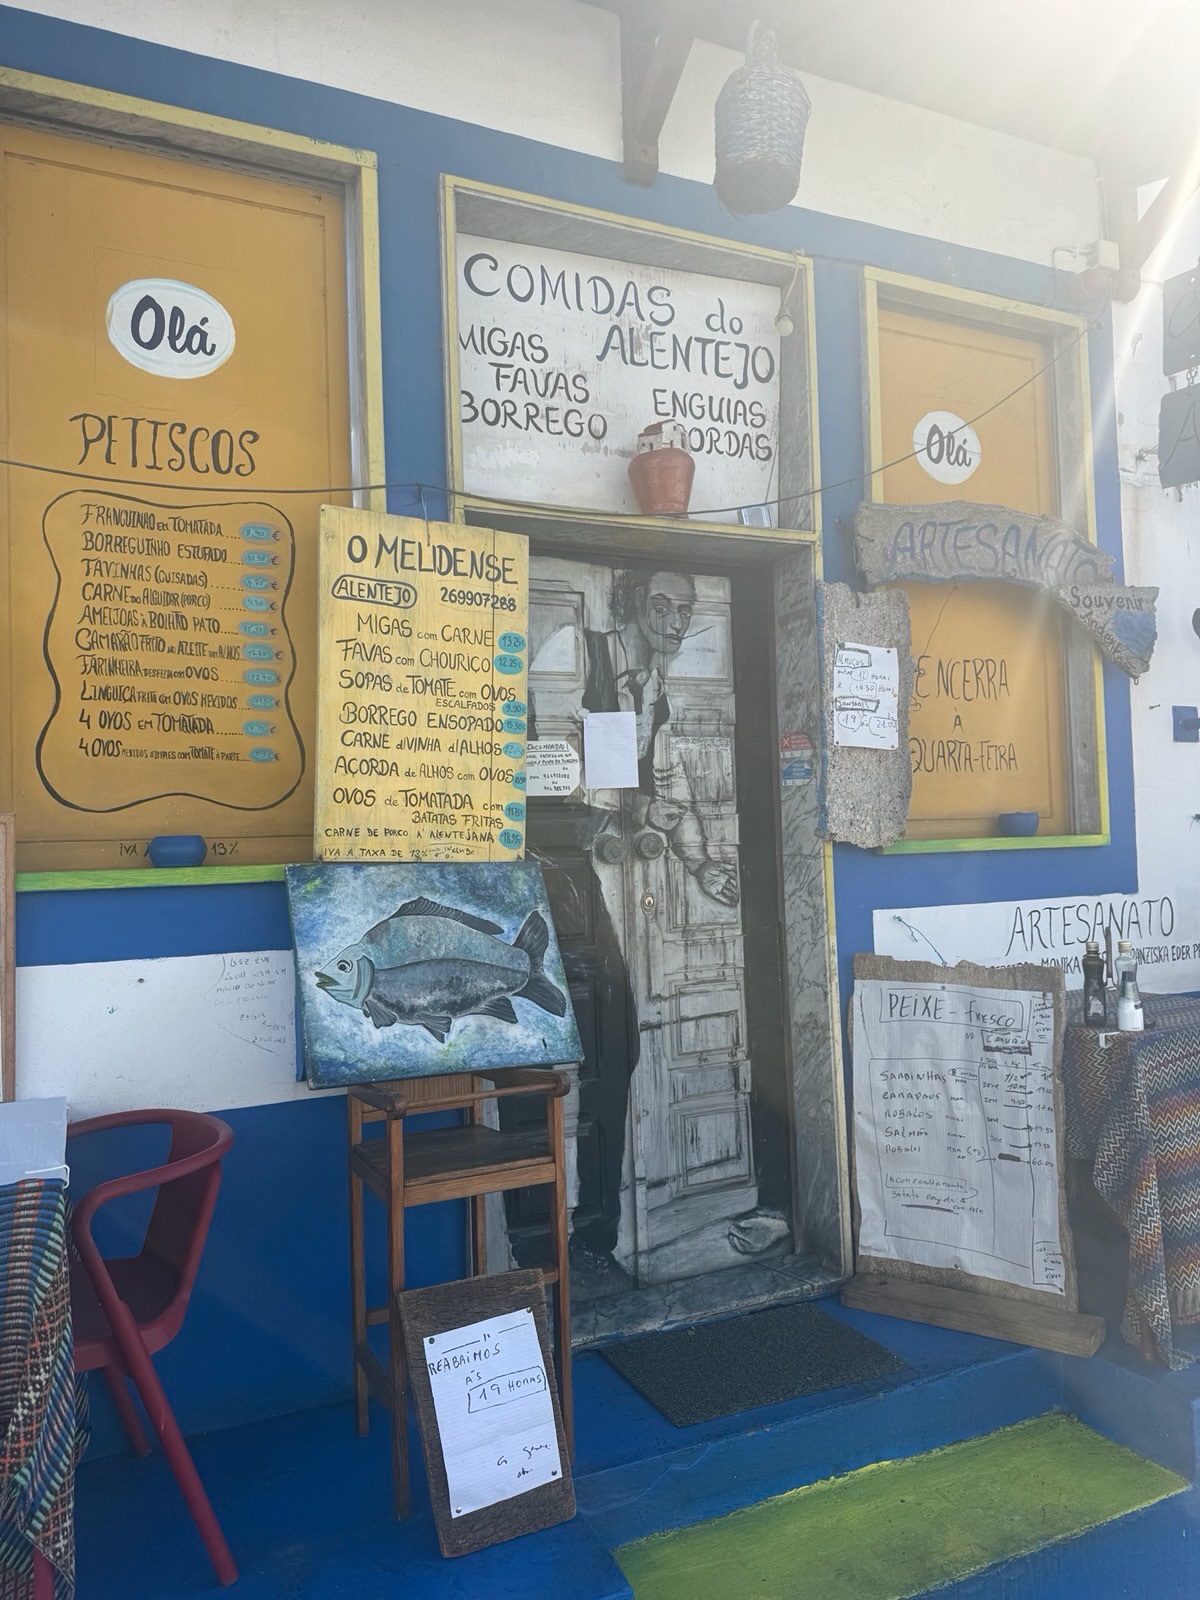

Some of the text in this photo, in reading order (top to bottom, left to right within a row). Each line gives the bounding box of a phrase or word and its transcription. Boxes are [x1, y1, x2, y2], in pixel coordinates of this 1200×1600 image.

[463, 253, 675, 327] COMIDAS
[131, 294, 216, 356] Olá
[705, 298, 743, 335] do
[459, 323, 549, 364] MIGAS
[596, 324, 775, 389] ALENTEJO
[488, 362, 590, 403] FAVAS
[461, 390, 608, 440] BORREGO
[652, 389, 766, 428] ENGUIAS
[69, 412, 260, 476] PETISCOS
[927, 424, 971, 467] Olá
[80, 503, 155, 531] FRANGUINHO
[167, 515, 224, 538] TOMATADA
[81, 530, 171, 557] BORREGUINHO
[177, 543, 227, 563] ESTUFADO
[347, 533, 518, 585] O MELIDENSE
[889, 519, 1100, 585] ARTESANATO
[81, 582, 132, 603] CARNE
[154, 564, 208, 589] (GUISADAS)
[336, 578, 411, 606] ALENTEJO
[440, 586, 517, 612] 269907288
[1070, 585, 1143, 614] Souvenir
[76, 604, 140, 628] AMEIJOAS
[192, 616, 221, 634] PATO
[357, 612, 413, 638] MIGAS
[417, 630, 438, 641] com
[441, 624, 495, 647] CARNE
[75, 627, 139, 652] CAMARÃO
[138, 634, 166, 653] FRITO
[336, 638, 393, 664] FAVAS
[395, 656, 415, 667] com
[419, 648, 491, 674] CHOURIÇO
[75, 653, 144, 677] FARINHEIRA
[185, 665, 219, 682] OVOS
[914, 655, 1011, 702] ENCERRA
[80, 679, 137, 704] LINGUIÇA
[172, 690, 200, 706] OVOS
[338, 669, 516, 702] SOPAS de TOMATE com OVOS
[339, 700, 418, 727] BORREGO
[427, 712, 504, 733] ENSOPADO
[436, 697, 496, 712] ESCALFADOS
[79, 708, 91, 730] 4
[99, 709, 132, 731] OVOS
[137, 719, 153, 731] EM
[151, 712, 215, 735] TOMATADA
[79, 737, 89, 758] 4
[91, 737, 122, 758] OVOS
[340, 729, 391, 749] CARNE
[909, 737, 1019, 773] QUARTA-FEIRA
[334, 755, 514, 784] AÇORDA de ALHOS com OVOS
[333, 787, 376, 807] OVOS
[384, 797, 399, 807] de
[398, 787, 474, 810] TOMATADA
[482, 801, 504, 812] com
[324, 827, 361, 838] CARNE
[367, 828, 380, 838] DE
[384, 828, 409, 837] PORCO
[429, 829, 495, 844] ALENTEJANA
[411, 811, 504, 829] BATATAS FRITAS
[210, 842, 238, 856] 13%
[324, 847, 341, 858] IVA
[359, 847, 388, 858] TAXA
[391, 849, 404, 858] DE
[1004, 896, 1175, 957] ARTESANATO
[1171, 944, 1192, 961] EDER
